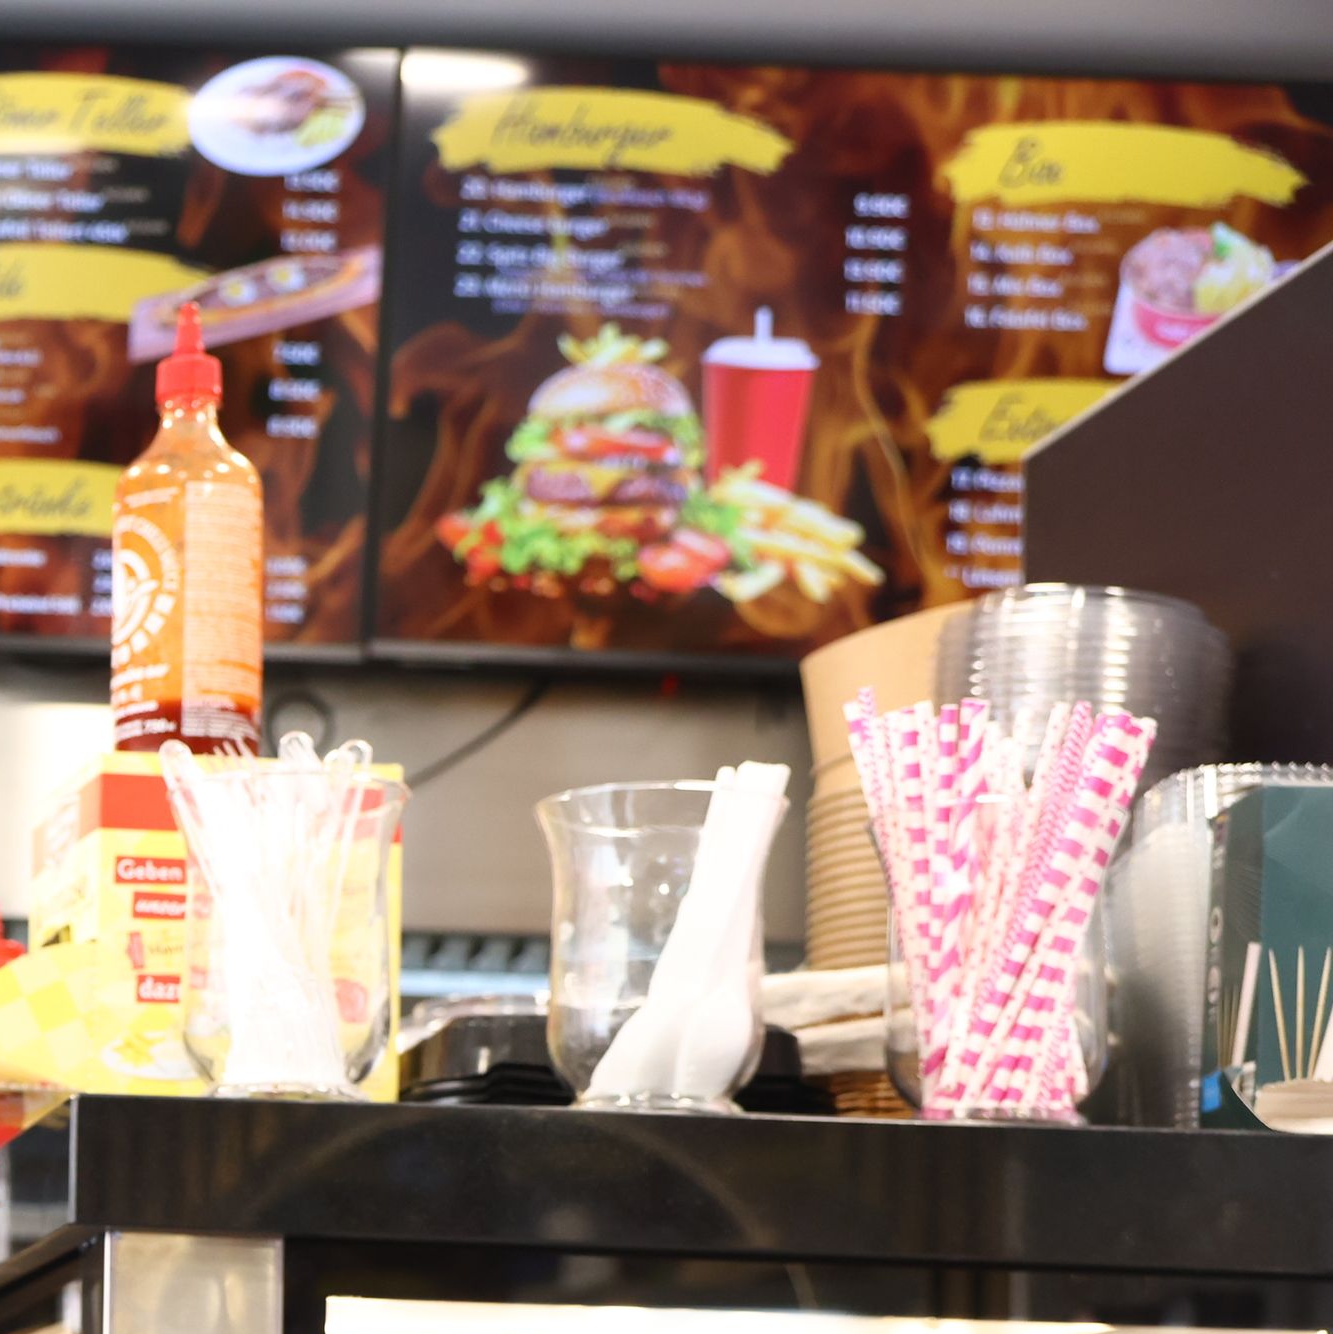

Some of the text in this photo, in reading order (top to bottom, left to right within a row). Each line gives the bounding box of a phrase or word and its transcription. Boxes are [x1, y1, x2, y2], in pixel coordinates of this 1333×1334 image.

[492, 95, 674, 165] Hamburger
[490, 178, 590, 207] Hamburger
[116, 857, 183, 882] Geben
